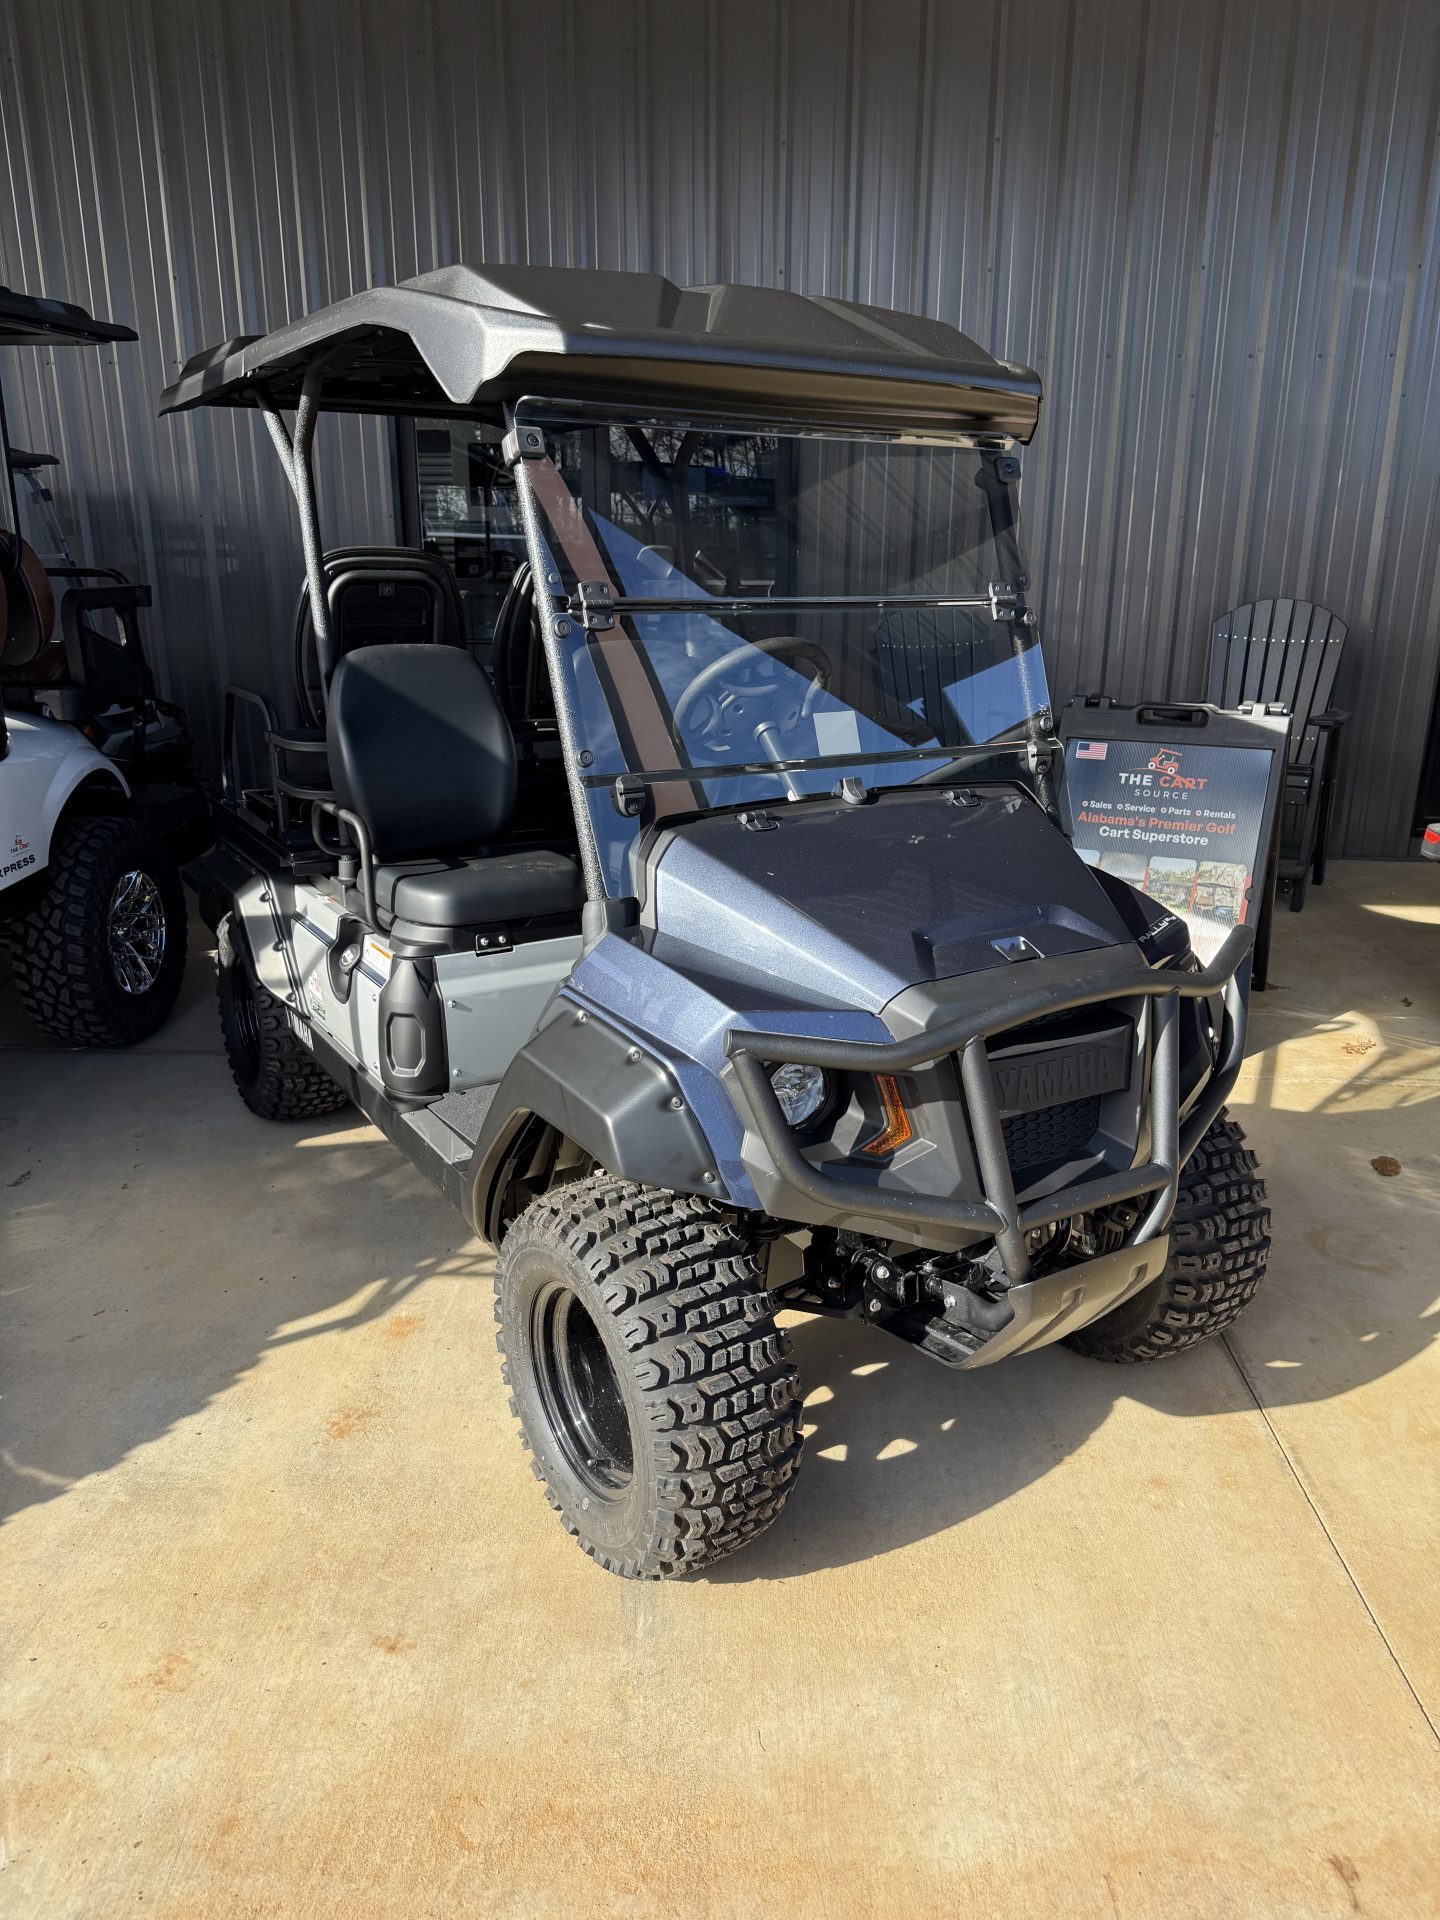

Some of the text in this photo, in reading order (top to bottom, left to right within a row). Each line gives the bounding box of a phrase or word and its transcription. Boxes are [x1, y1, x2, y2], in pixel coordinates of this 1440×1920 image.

[1119, 772, 1208, 790] THE CART
[1134, 788, 1188, 800] SOURCE
[1089, 800, 1236, 820] Sales Service Parts Rentals
[1078, 811, 1236, 836] Alabama's Premier Golf
[1099, 825, 1209, 846] Cart Superstore
[996, 1046, 1112, 1107] YAMAHA
